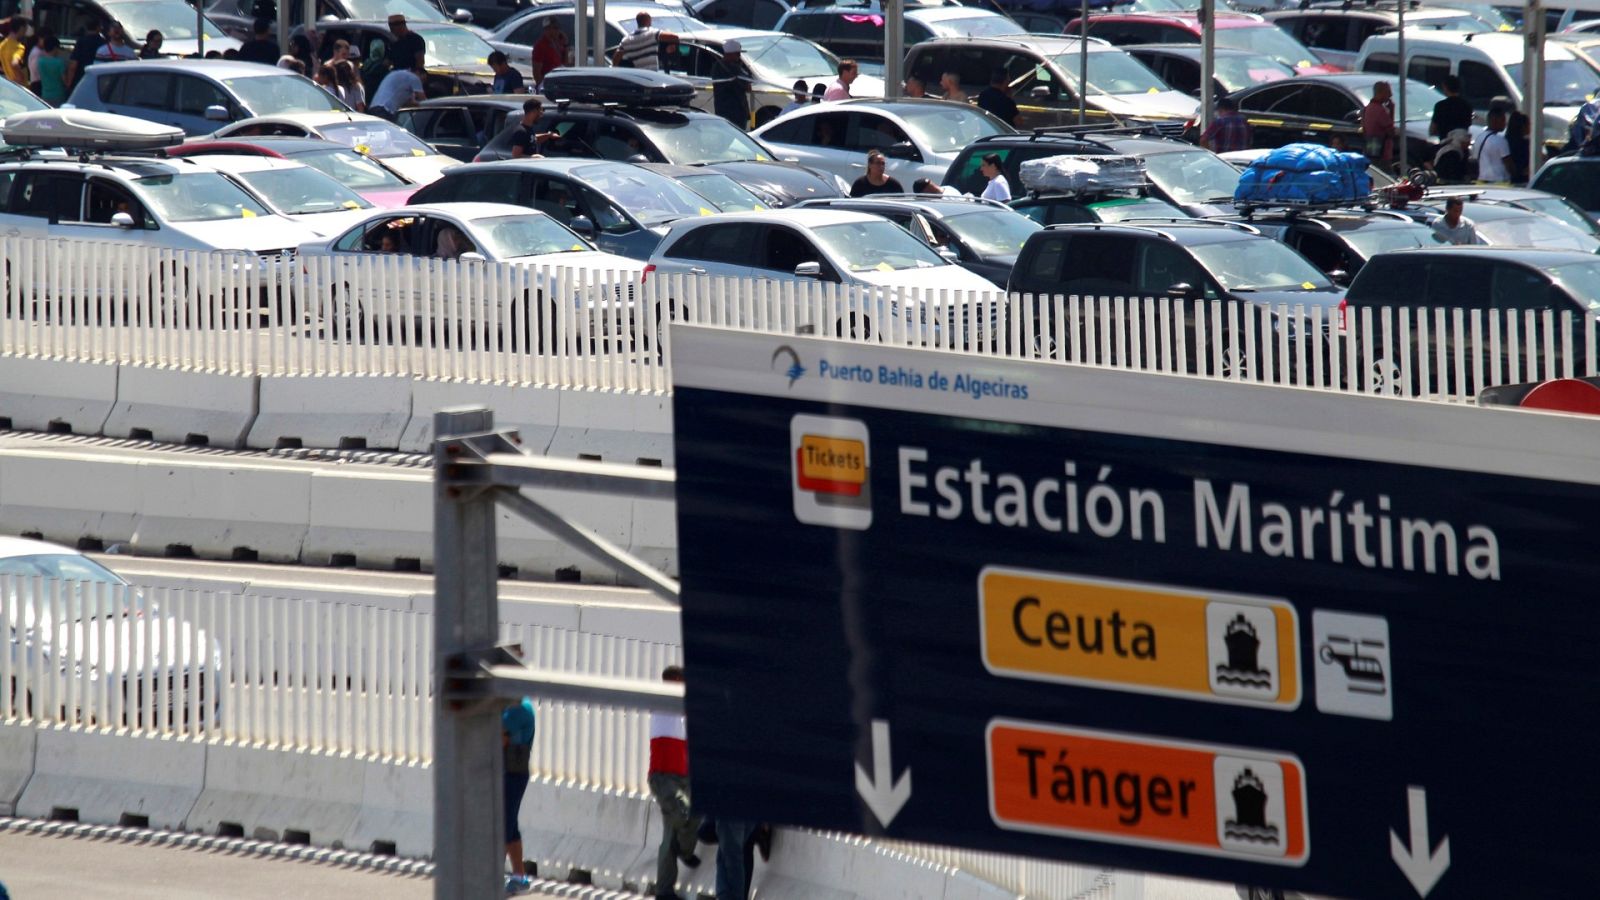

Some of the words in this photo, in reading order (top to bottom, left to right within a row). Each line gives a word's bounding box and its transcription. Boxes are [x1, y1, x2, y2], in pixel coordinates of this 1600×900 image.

[820, 361, 873, 383] Puerto
[928, 370, 948, 392] de
[955, 375, 1029, 400] Algeciras
[806, 447, 860, 470] Tickets
[898, 446, 1166, 544] Estación
[1194, 479, 1501, 581] Marítima
[1011, 597, 1158, 661] Ceuta
[1016, 746, 1197, 827] Tánger
